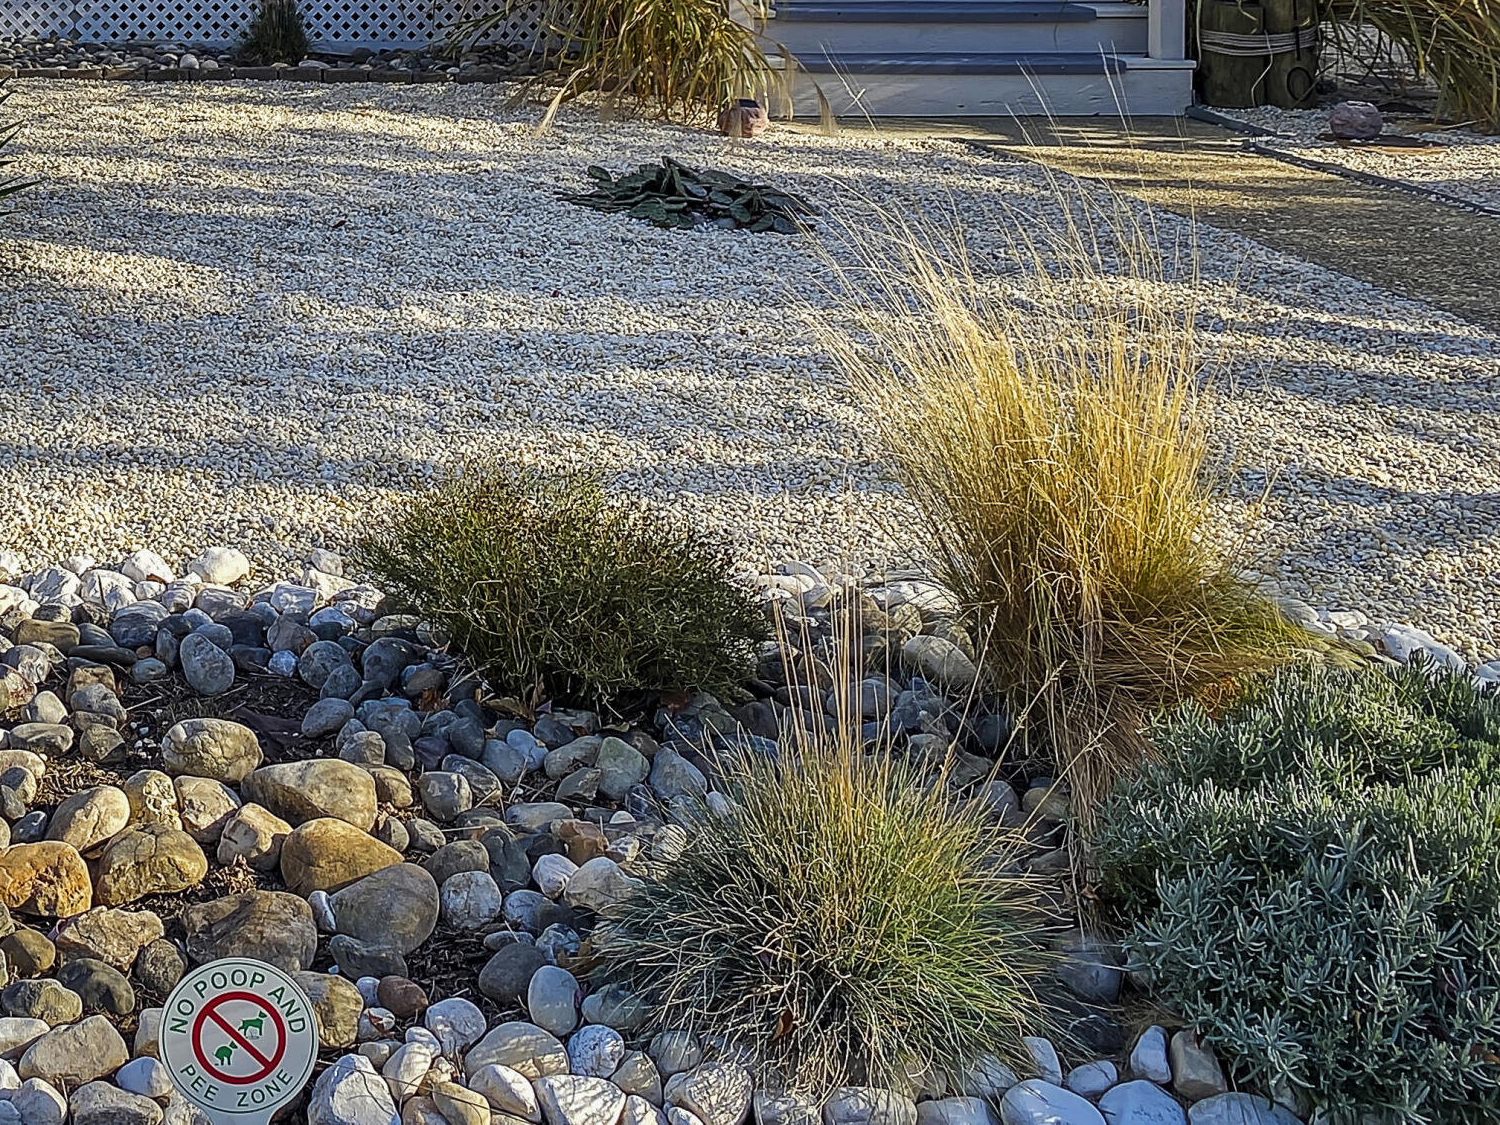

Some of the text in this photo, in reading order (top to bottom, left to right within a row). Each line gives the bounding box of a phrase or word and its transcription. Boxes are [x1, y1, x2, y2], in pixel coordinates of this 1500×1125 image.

[169, 969, 306, 1034] NO POOP AND
[180, 1064, 293, 1107] PEE ZONE
